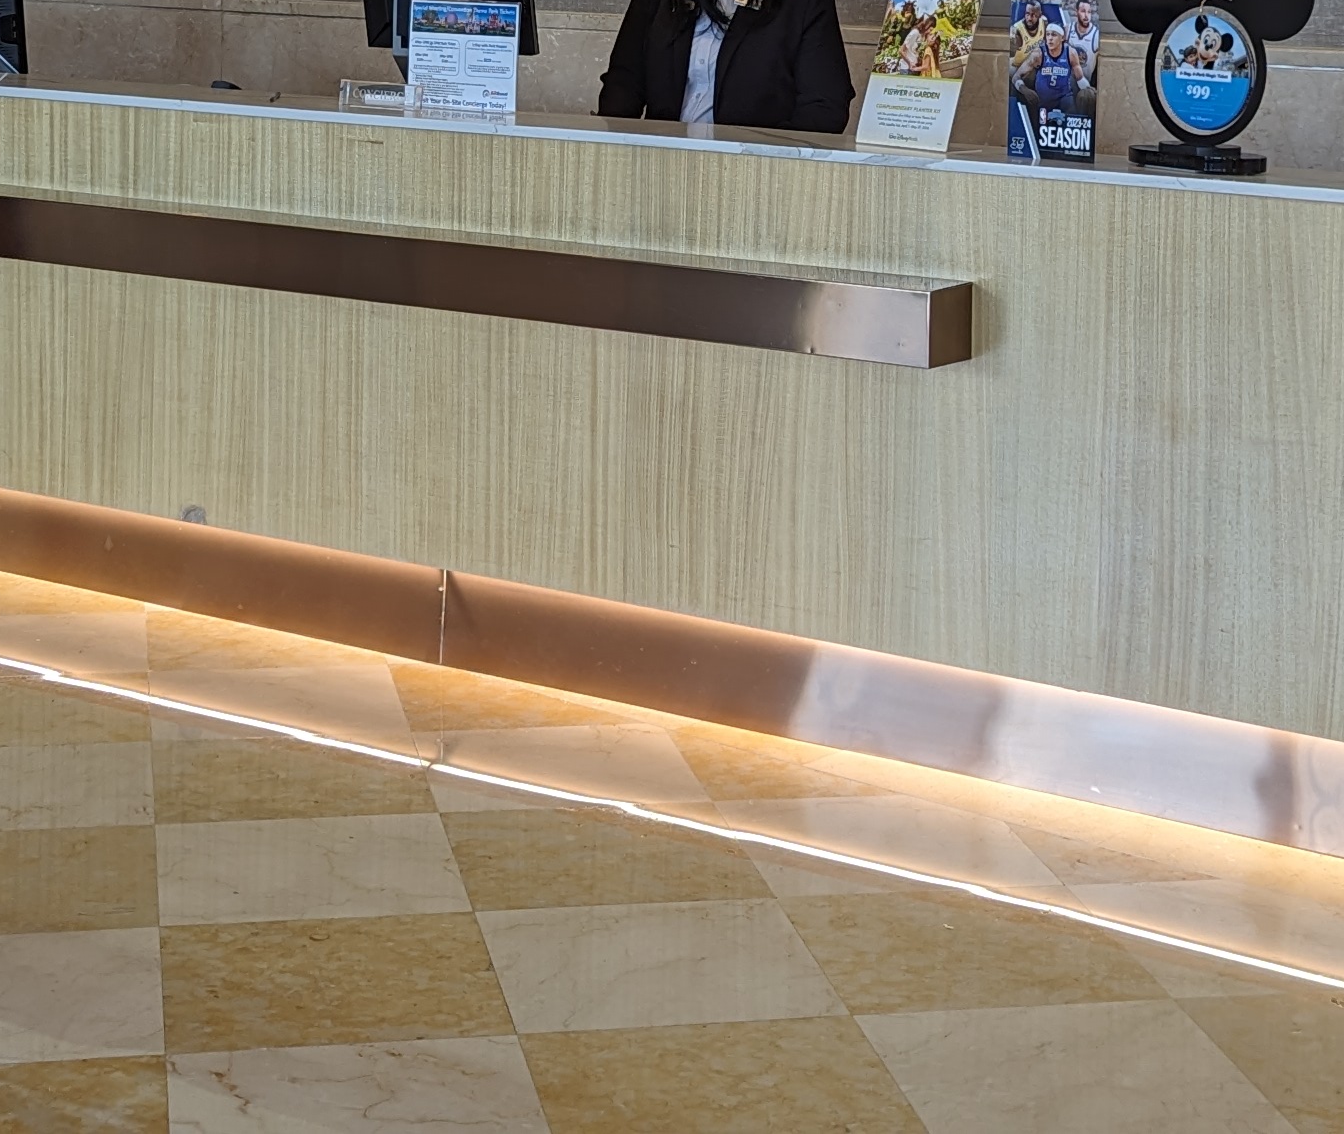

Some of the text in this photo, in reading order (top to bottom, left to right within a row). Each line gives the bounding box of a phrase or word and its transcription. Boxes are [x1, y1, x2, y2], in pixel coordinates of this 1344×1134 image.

[1049, 75, 1058, 87] 5
[913, 90, 941, 99] GARDEN
[1186, 84, 1211, 100] $99
[1066, 117, 1092, 128] 2023-24
[1038, 126, 1091, 151] SEASON
